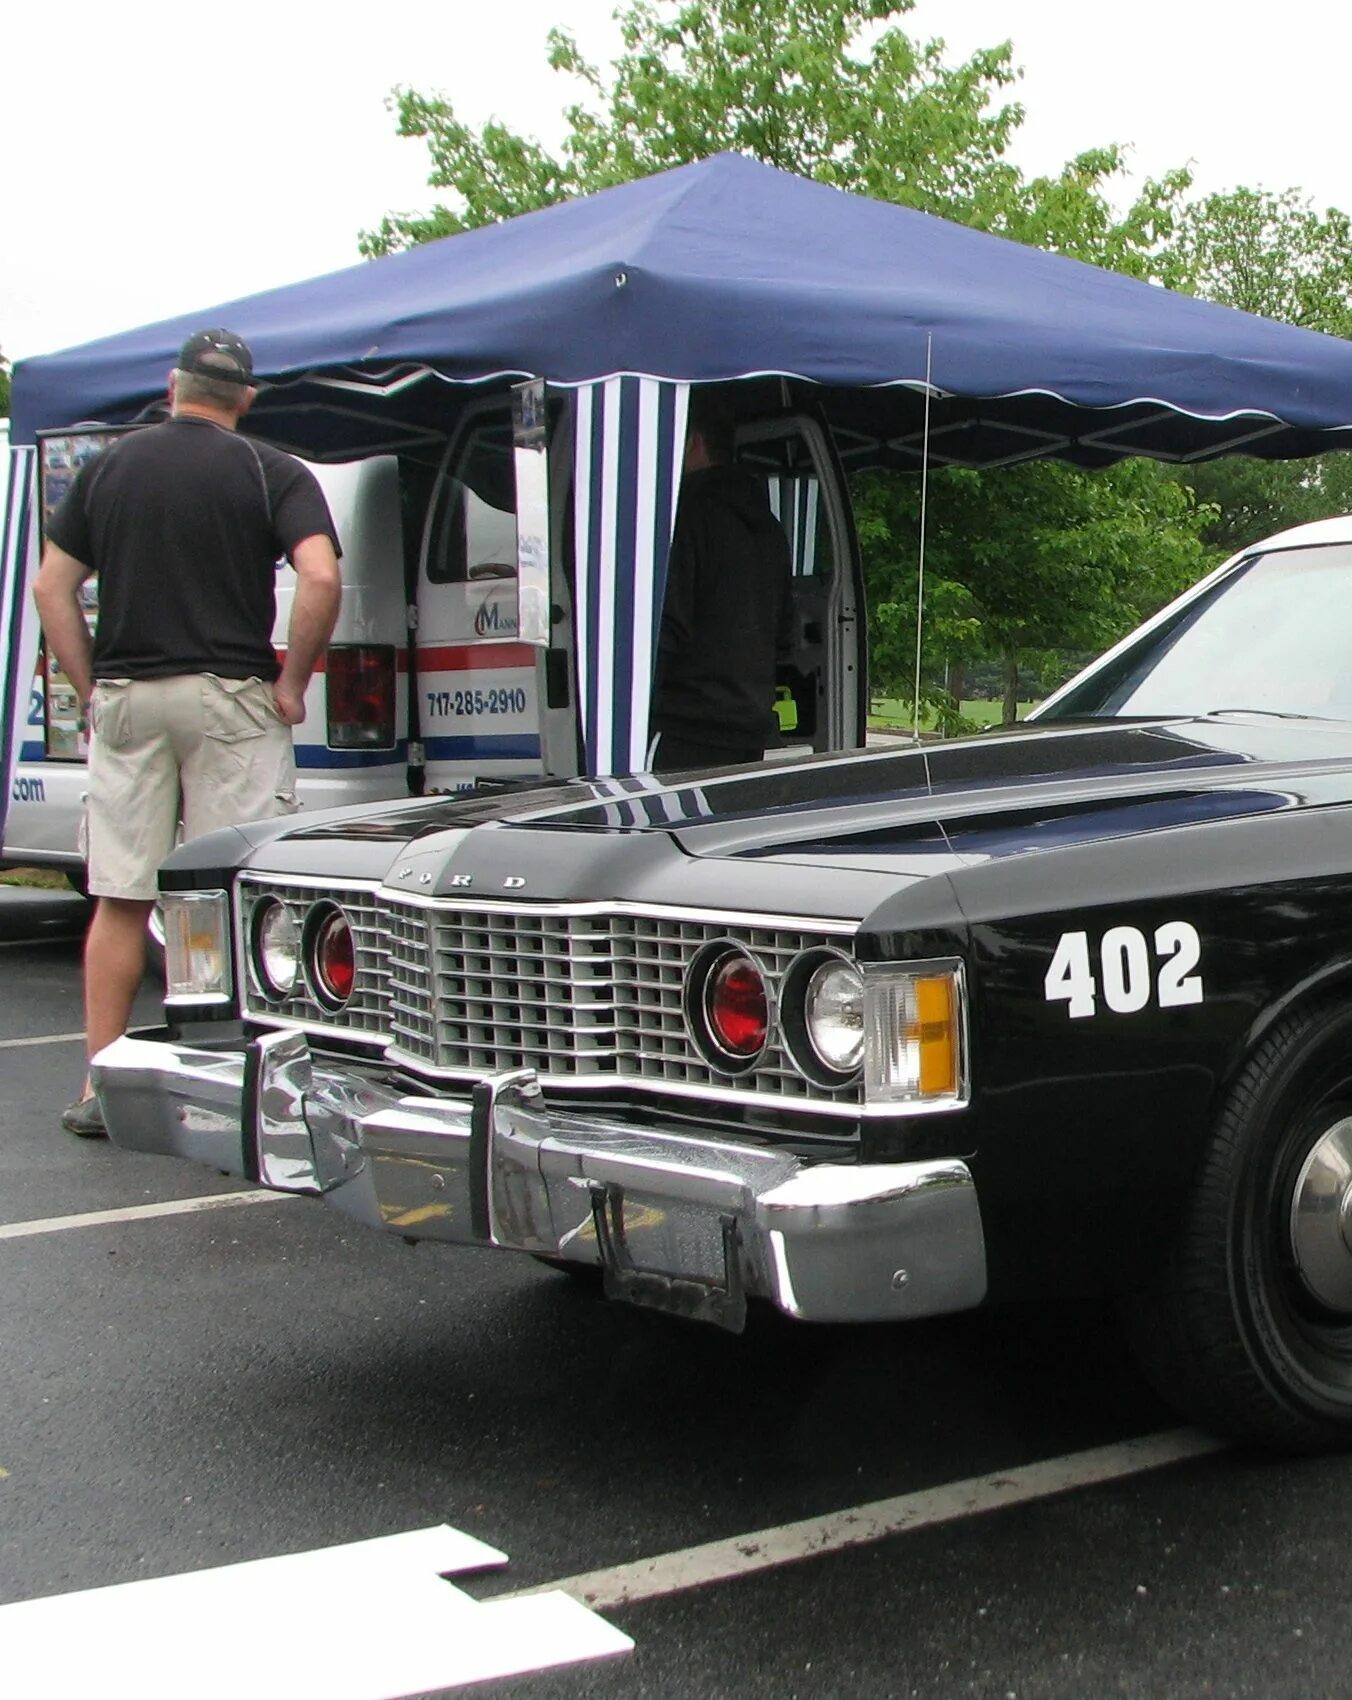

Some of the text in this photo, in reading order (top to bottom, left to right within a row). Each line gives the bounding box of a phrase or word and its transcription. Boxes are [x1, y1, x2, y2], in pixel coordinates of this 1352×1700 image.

[427, 688, 526, 717] 717-285-2910
[399, 868, 527, 889] FORD
[1044, 920, 1203, 1019] 402
